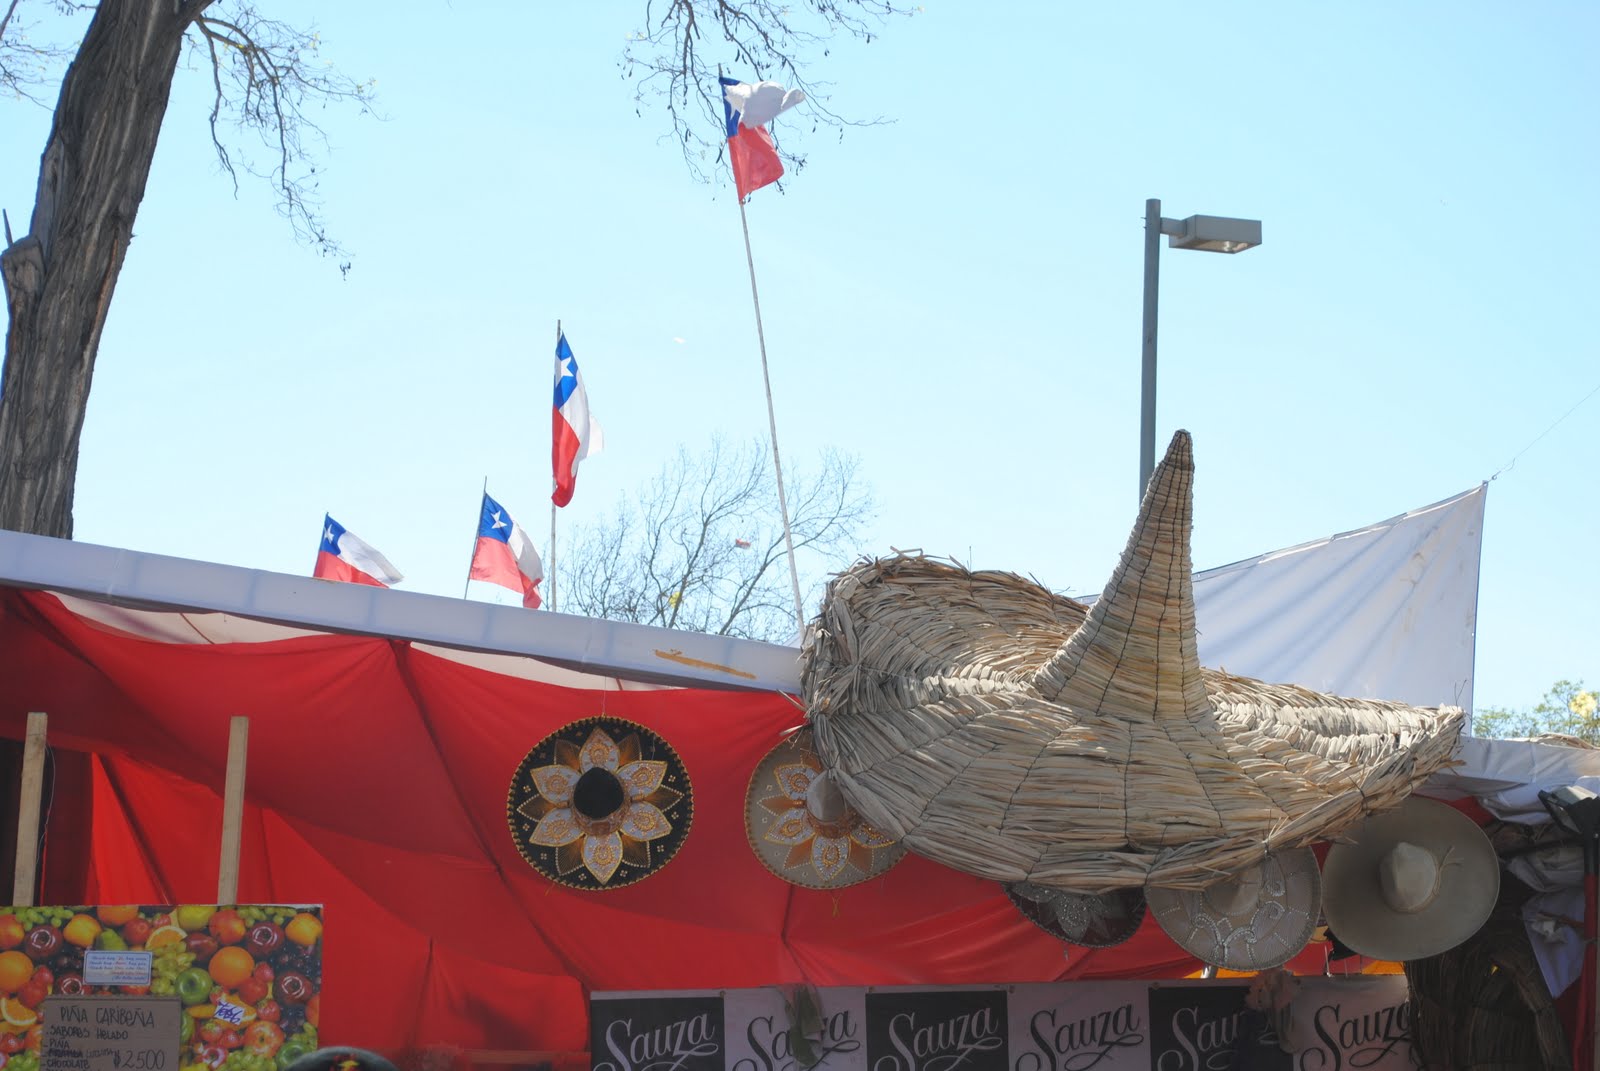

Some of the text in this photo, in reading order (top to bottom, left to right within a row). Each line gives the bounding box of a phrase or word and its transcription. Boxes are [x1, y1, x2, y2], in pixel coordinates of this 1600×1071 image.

[60, 1005, 88, 1022] PIÑA
[593, 1011, 719, 1071] Sauza
[733, 1010, 861, 1071] Saa
[873, 1006, 1003, 1071] Sauza
[1015, 1003, 1144, 1071] Sauza
[113, 1049, 165, 1070] $2500
